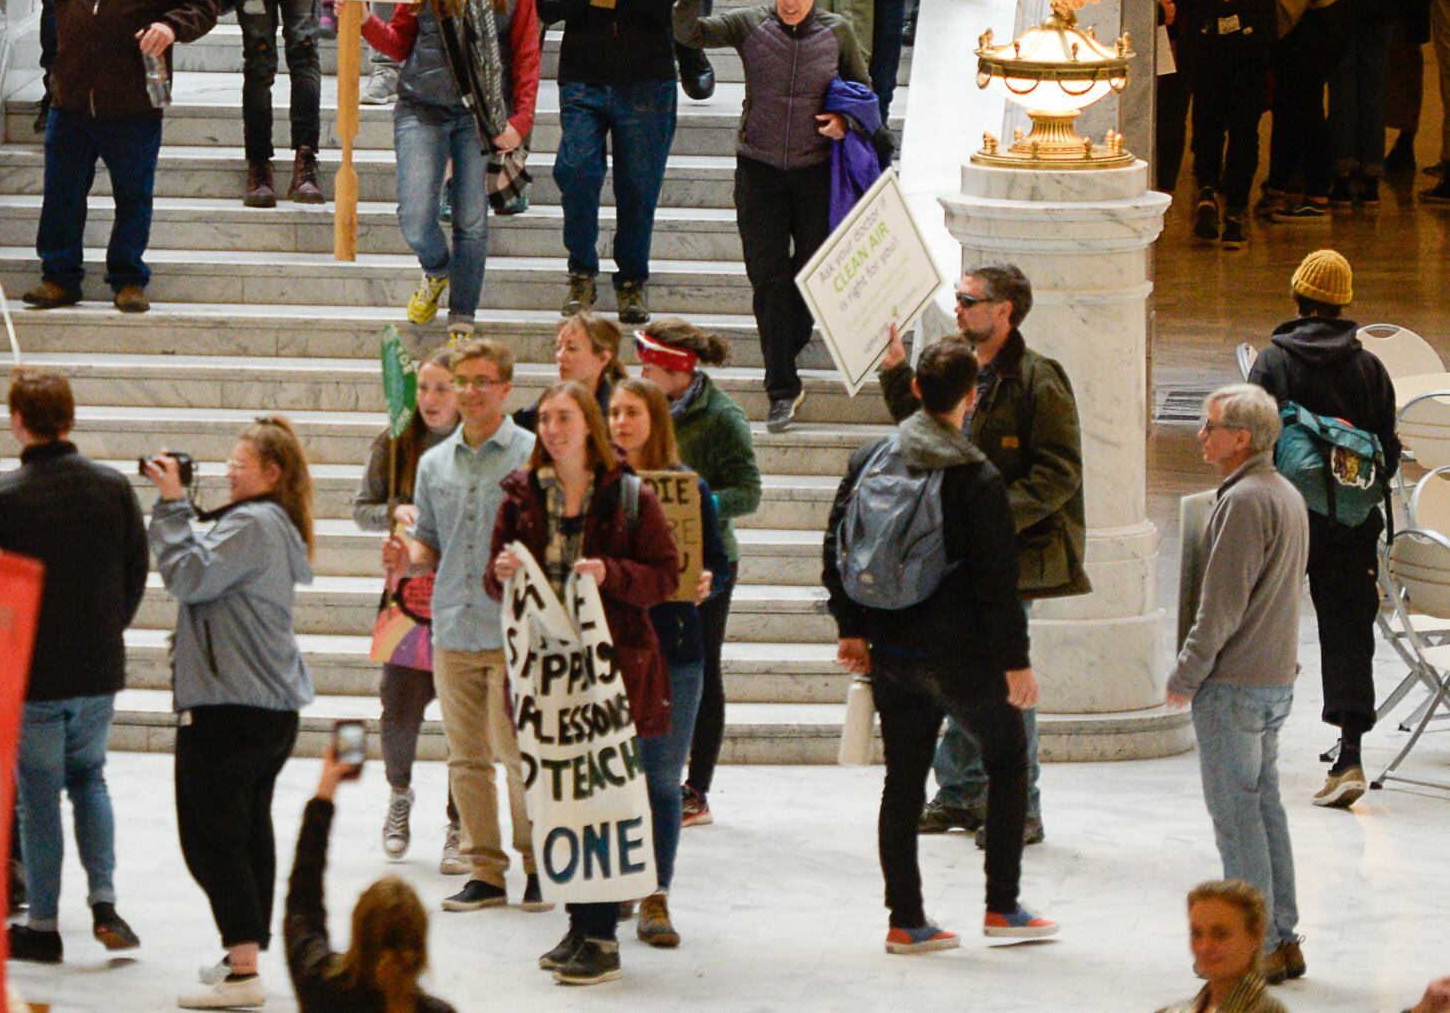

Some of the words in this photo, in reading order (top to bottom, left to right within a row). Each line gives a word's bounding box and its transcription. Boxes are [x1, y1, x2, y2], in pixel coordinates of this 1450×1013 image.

[833, 247, 870, 293] CLEAN
[869, 220, 891, 252] AIR
[540, 735, 646, 803] TEACH
[543, 816, 647, 885] ONE
